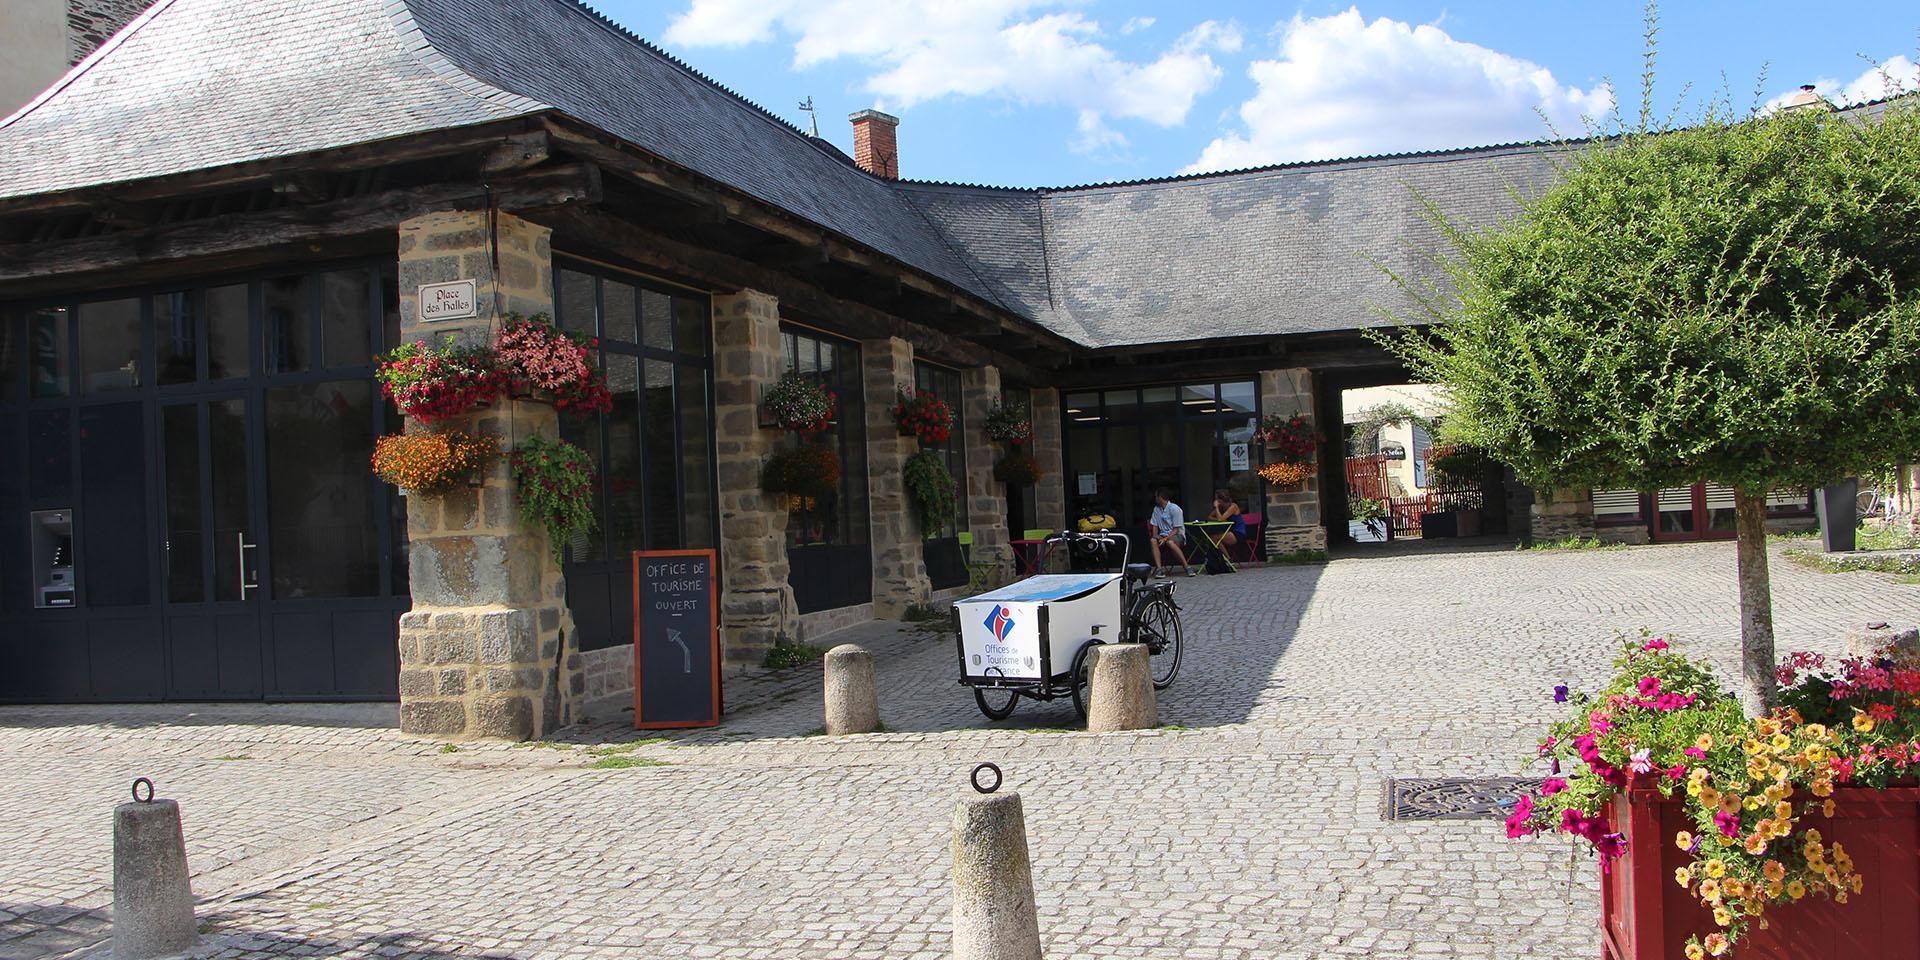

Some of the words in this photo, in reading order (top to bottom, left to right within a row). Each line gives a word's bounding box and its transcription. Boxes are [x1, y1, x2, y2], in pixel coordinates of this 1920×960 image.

[436, 289, 459, 302] Place
[426, 304, 440, 313] des
[693, 563, 705, 574] DE
[655, 600, 697, 610] OUVERT
[985, 644, 1009, 654] Offices
[986, 655, 1020, 665] Tourisme
